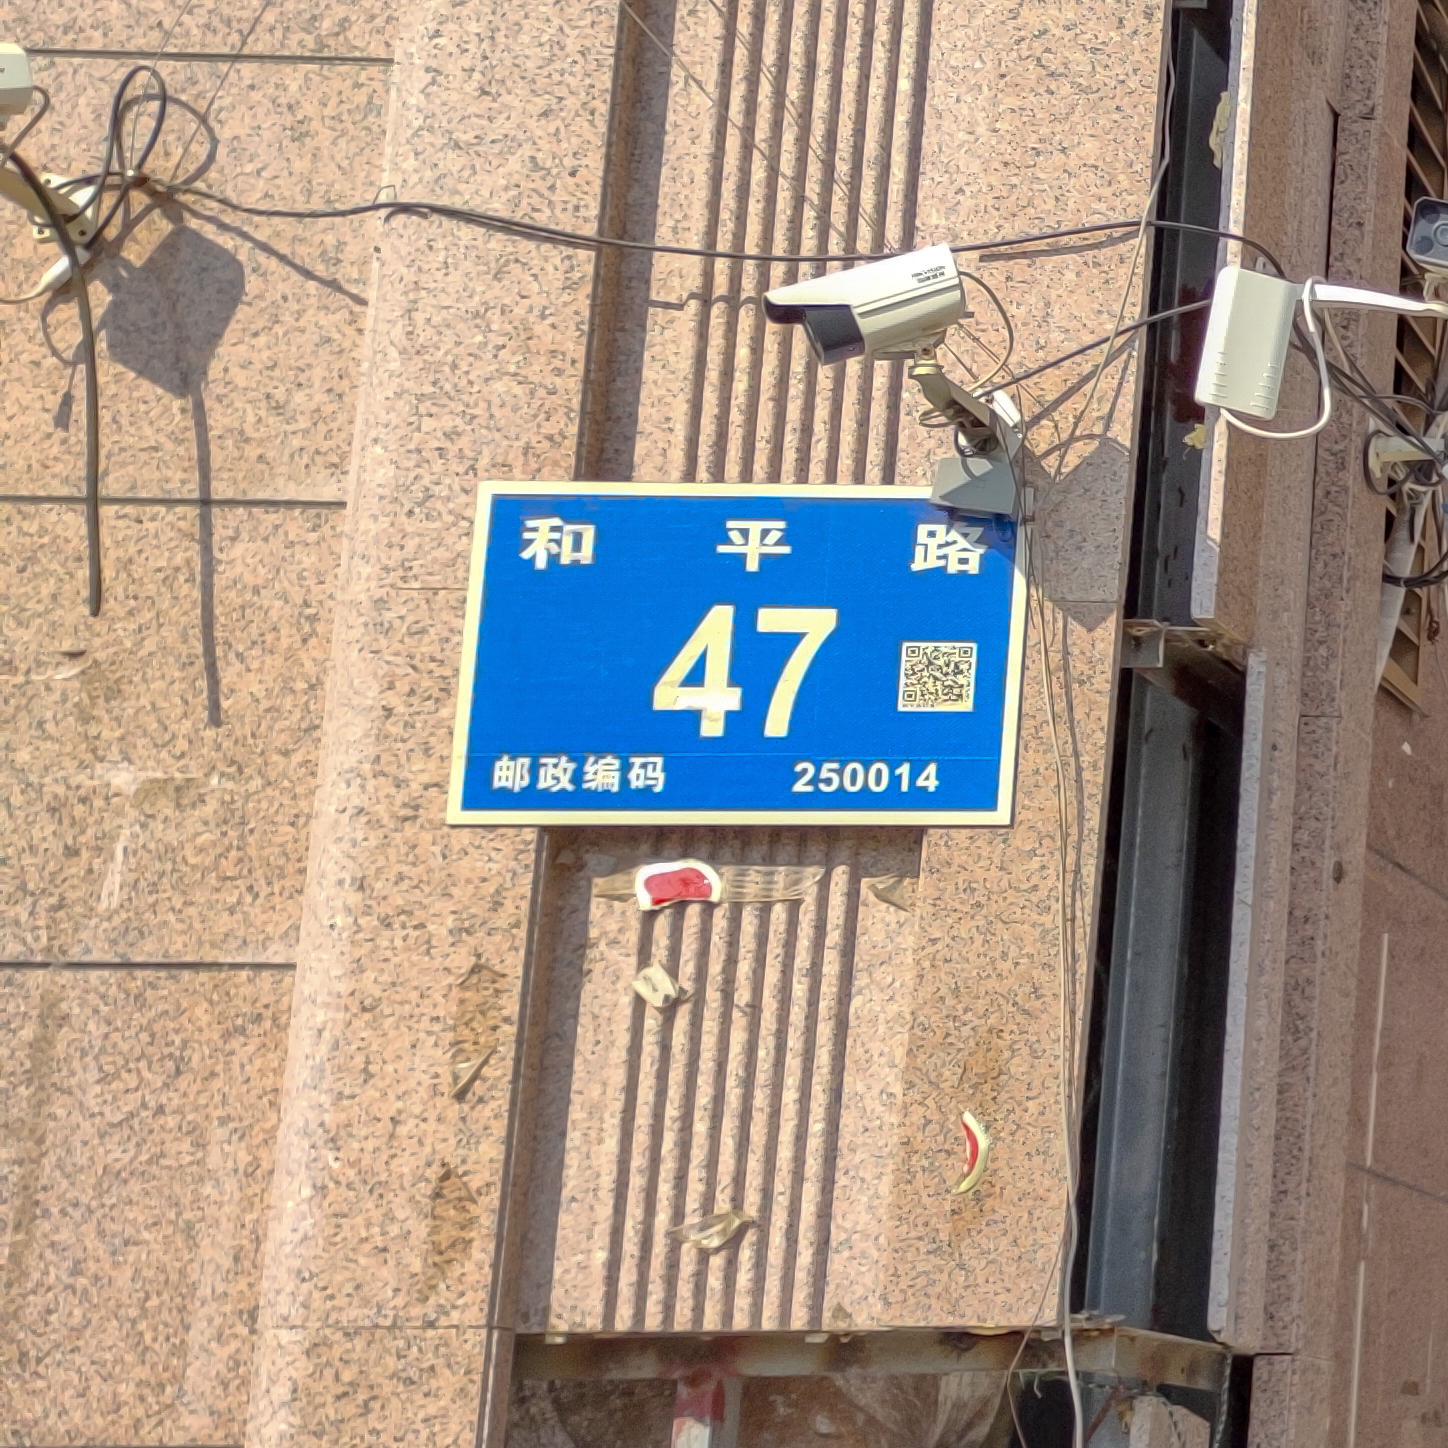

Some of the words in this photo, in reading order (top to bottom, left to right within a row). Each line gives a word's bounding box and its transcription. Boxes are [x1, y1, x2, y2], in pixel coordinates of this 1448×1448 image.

[520, 517, 987, 574] 和平路
[652, 604, 839, 738] 47
[492, 755, 665, 794] 邮政编码
[792, 761, 940, 793] 250014
